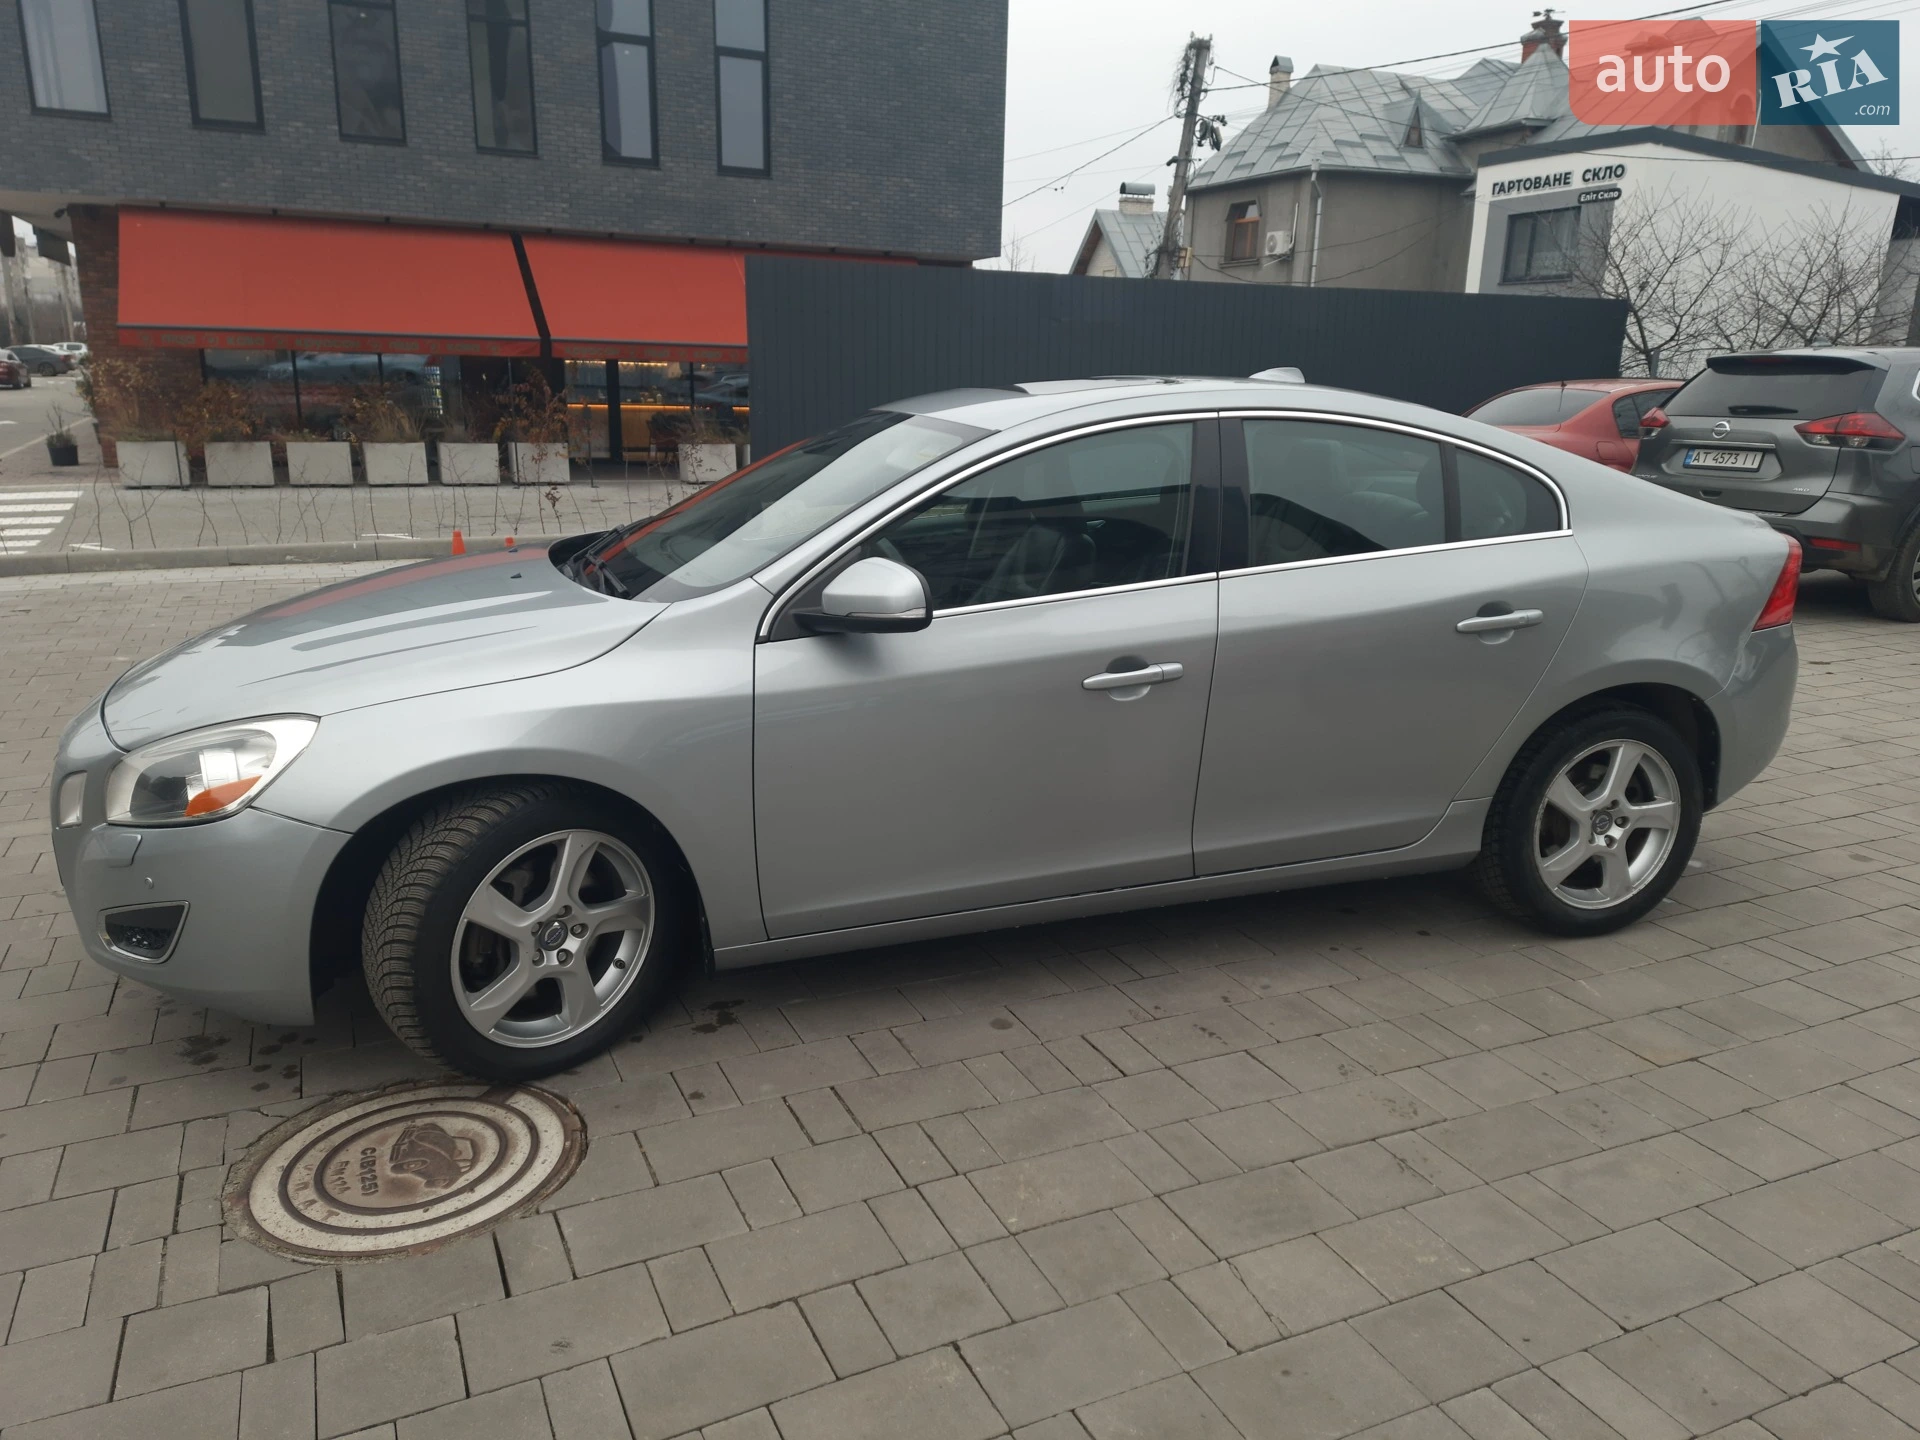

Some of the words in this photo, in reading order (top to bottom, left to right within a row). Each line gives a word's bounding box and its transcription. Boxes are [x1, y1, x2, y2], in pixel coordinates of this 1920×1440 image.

[1491, 171, 1572, 196] ГАРТОВАНЕ
[1581, 163, 1626, 183] СКЛО
[1598, 189, 1620, 200] Скло
[1692, 452, 1712, 463] AT
[1712, 453, 1739, 465] 4573
